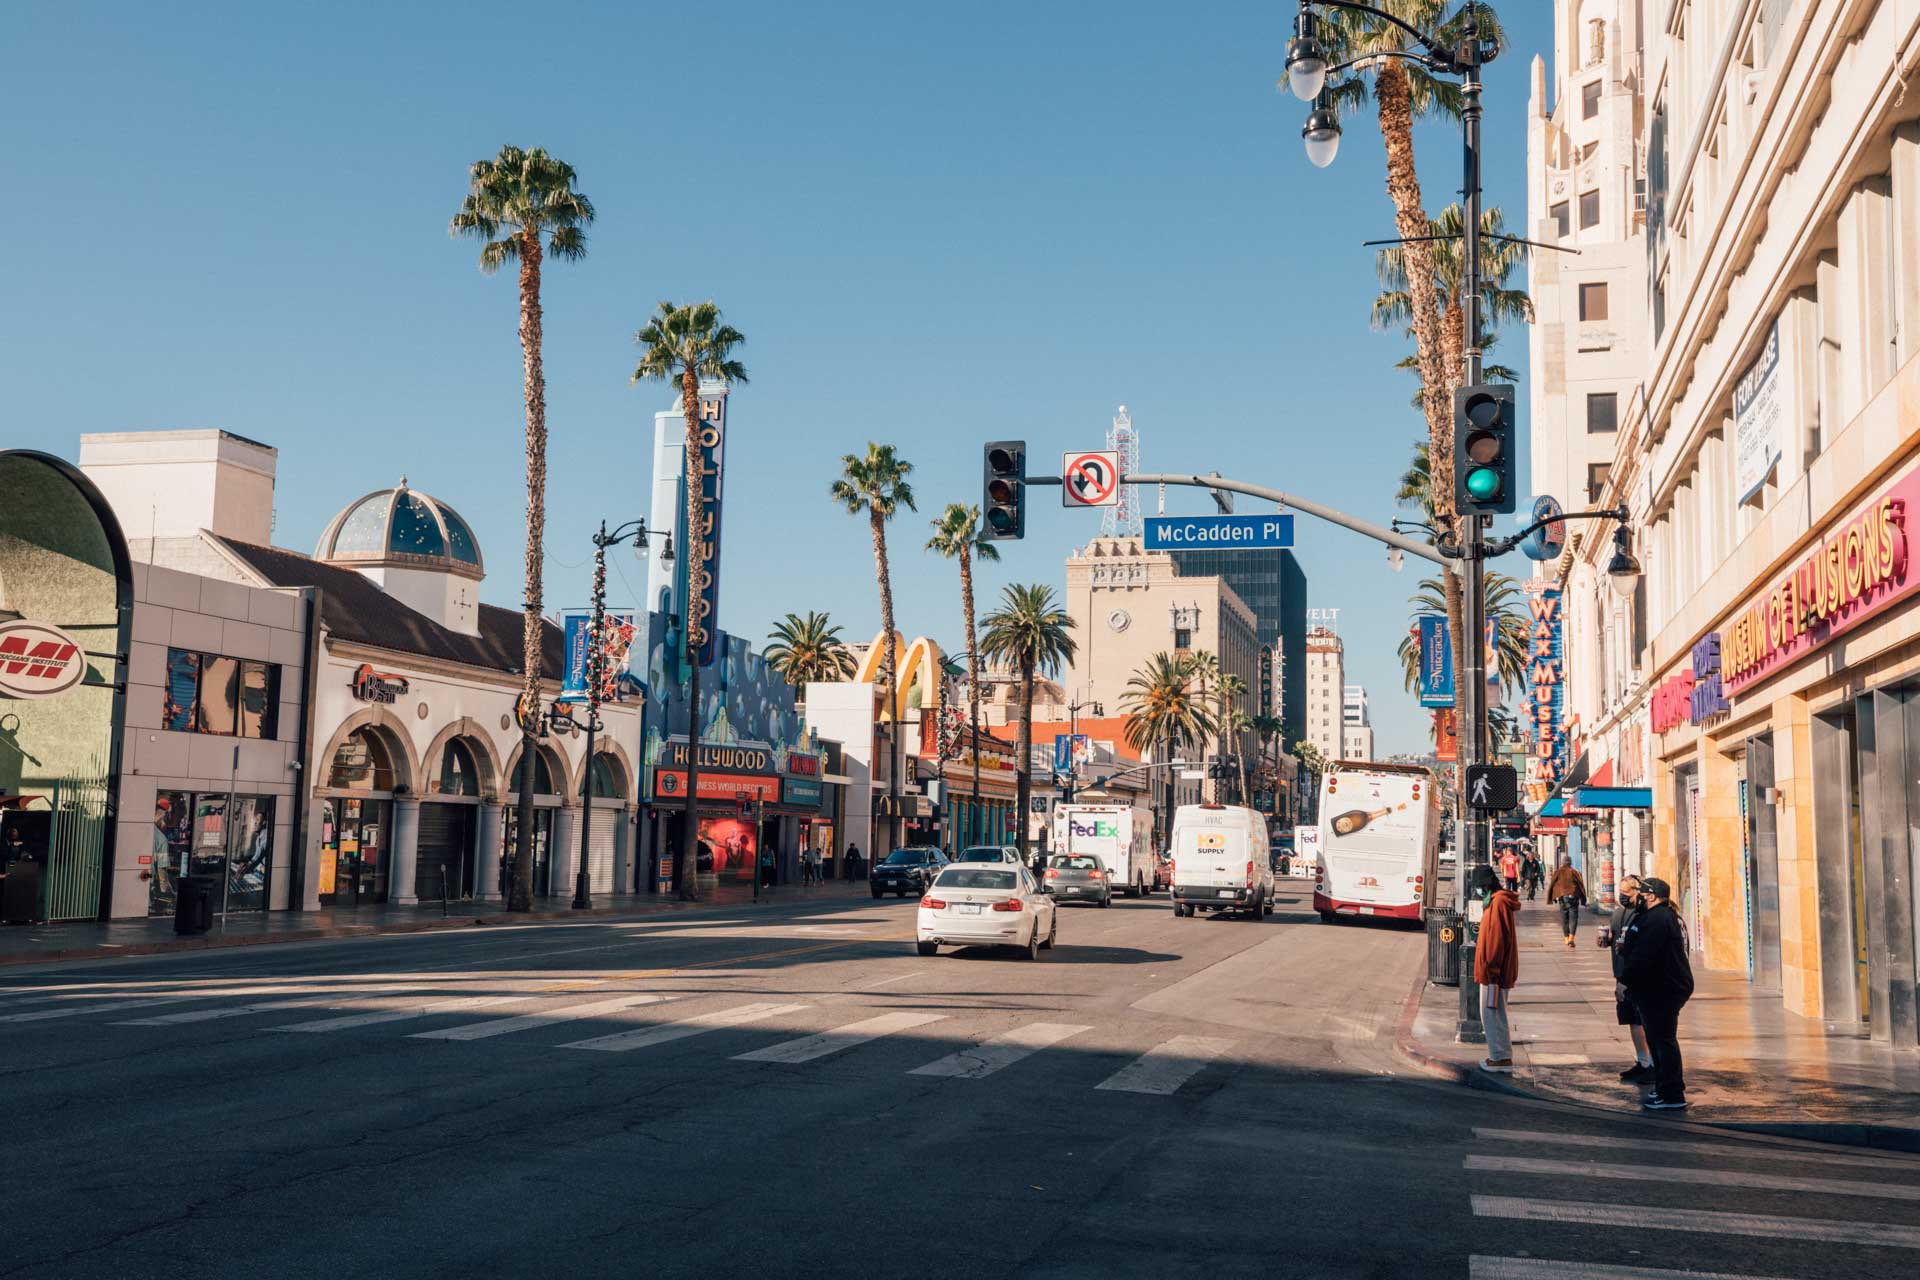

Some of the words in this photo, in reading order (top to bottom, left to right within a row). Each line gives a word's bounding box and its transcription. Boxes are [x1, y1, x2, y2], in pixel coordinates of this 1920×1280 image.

[1737, 375, 1753, 413] FOR
[1754, 330, 1776, 390] LEASE
[1157, 524, 1254, 542] McCadden
[1263, 522, 1280, 540] Pl
[1720, 604, 1767, 682] MUSEUM
[1769, 582, 1792, 650] OF
[1791, 495, 1894, 639] ILLUSIONS
[571, 620, 585, 679] Nutcracker
[1430, 622, 1444, 682] Nutcracker
[1529, 597, 1557, 657] WAX
[31, 657, 69, 667] INSTITUTE
[1262, 661, 1271, 717] CAPIT
[1532, 659, 1558, 780] MUSEUM
[682, 780, 717, 791] GNESS
[718, 783, 742, 792] WORLD
[742, 784, 773, 794] RECODS
[1070, 820, 1118, 837] FedEx
[1204, 816, 1223, 825] HVAC
[1301, 833, 1318, 844] Fed
